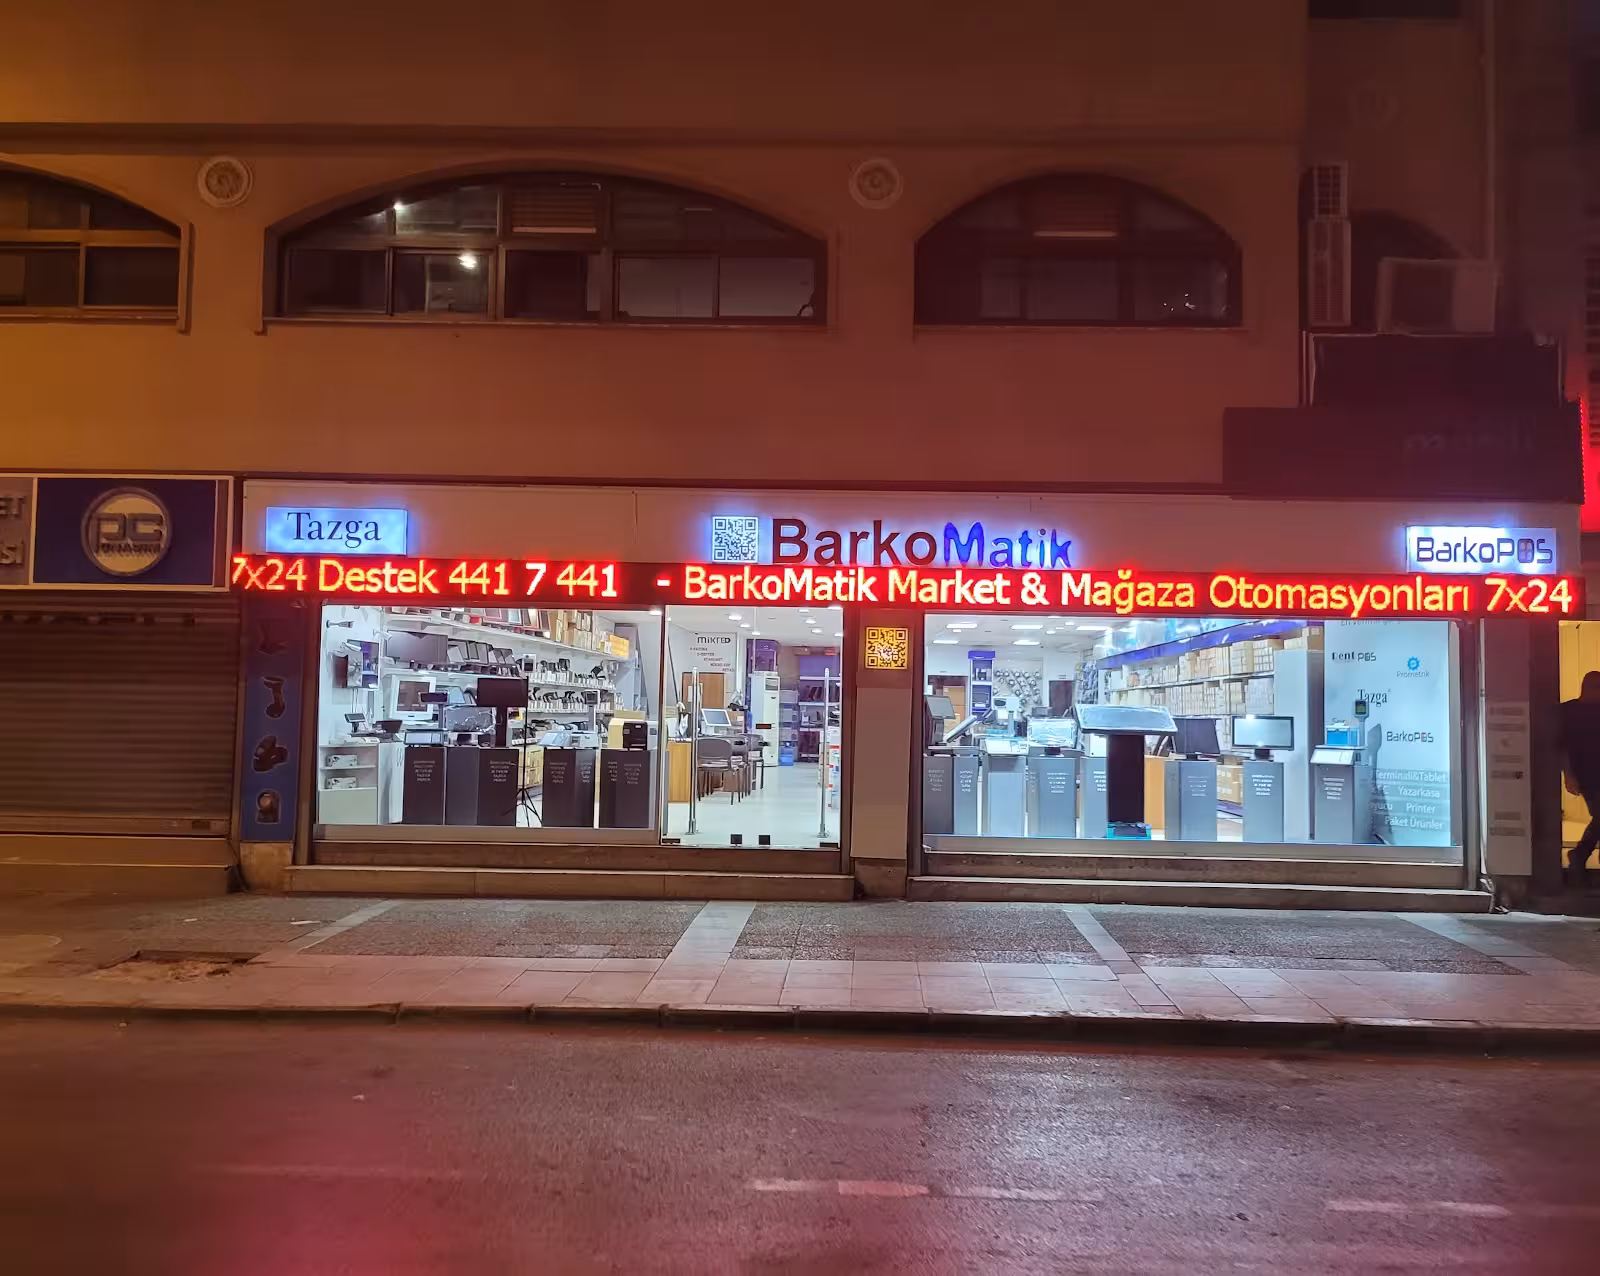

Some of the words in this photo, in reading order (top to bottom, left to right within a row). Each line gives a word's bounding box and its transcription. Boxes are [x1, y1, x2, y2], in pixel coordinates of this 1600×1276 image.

[287, 512, 382, 548] Tazga
[772, 518, 1072, 568] BarkoMatik
[1416, 537, 1554, 564] BarkoPOS
[231, 557, 307, 591] 7x24
[319, 559, 439, 593] Destek
[449, 562, 509, 595] 441
[525, 563, 547, 596] 7
[556, 564, 617, 597] 441
[685, 565, 878, 602] BarkoMatik
[888, 569, 1011, 605] Market
[1021, 572, 1050, 605] &
[1061, 569, 1195, 614] Mağaza
[1209, 575, 1469, 618] Otomasyonları
[1485, 577, 1573, 613] 7x24
[1386, 730, 1435, 743] BarkoPOS
[1406, 802, 1437, 815] Printer
